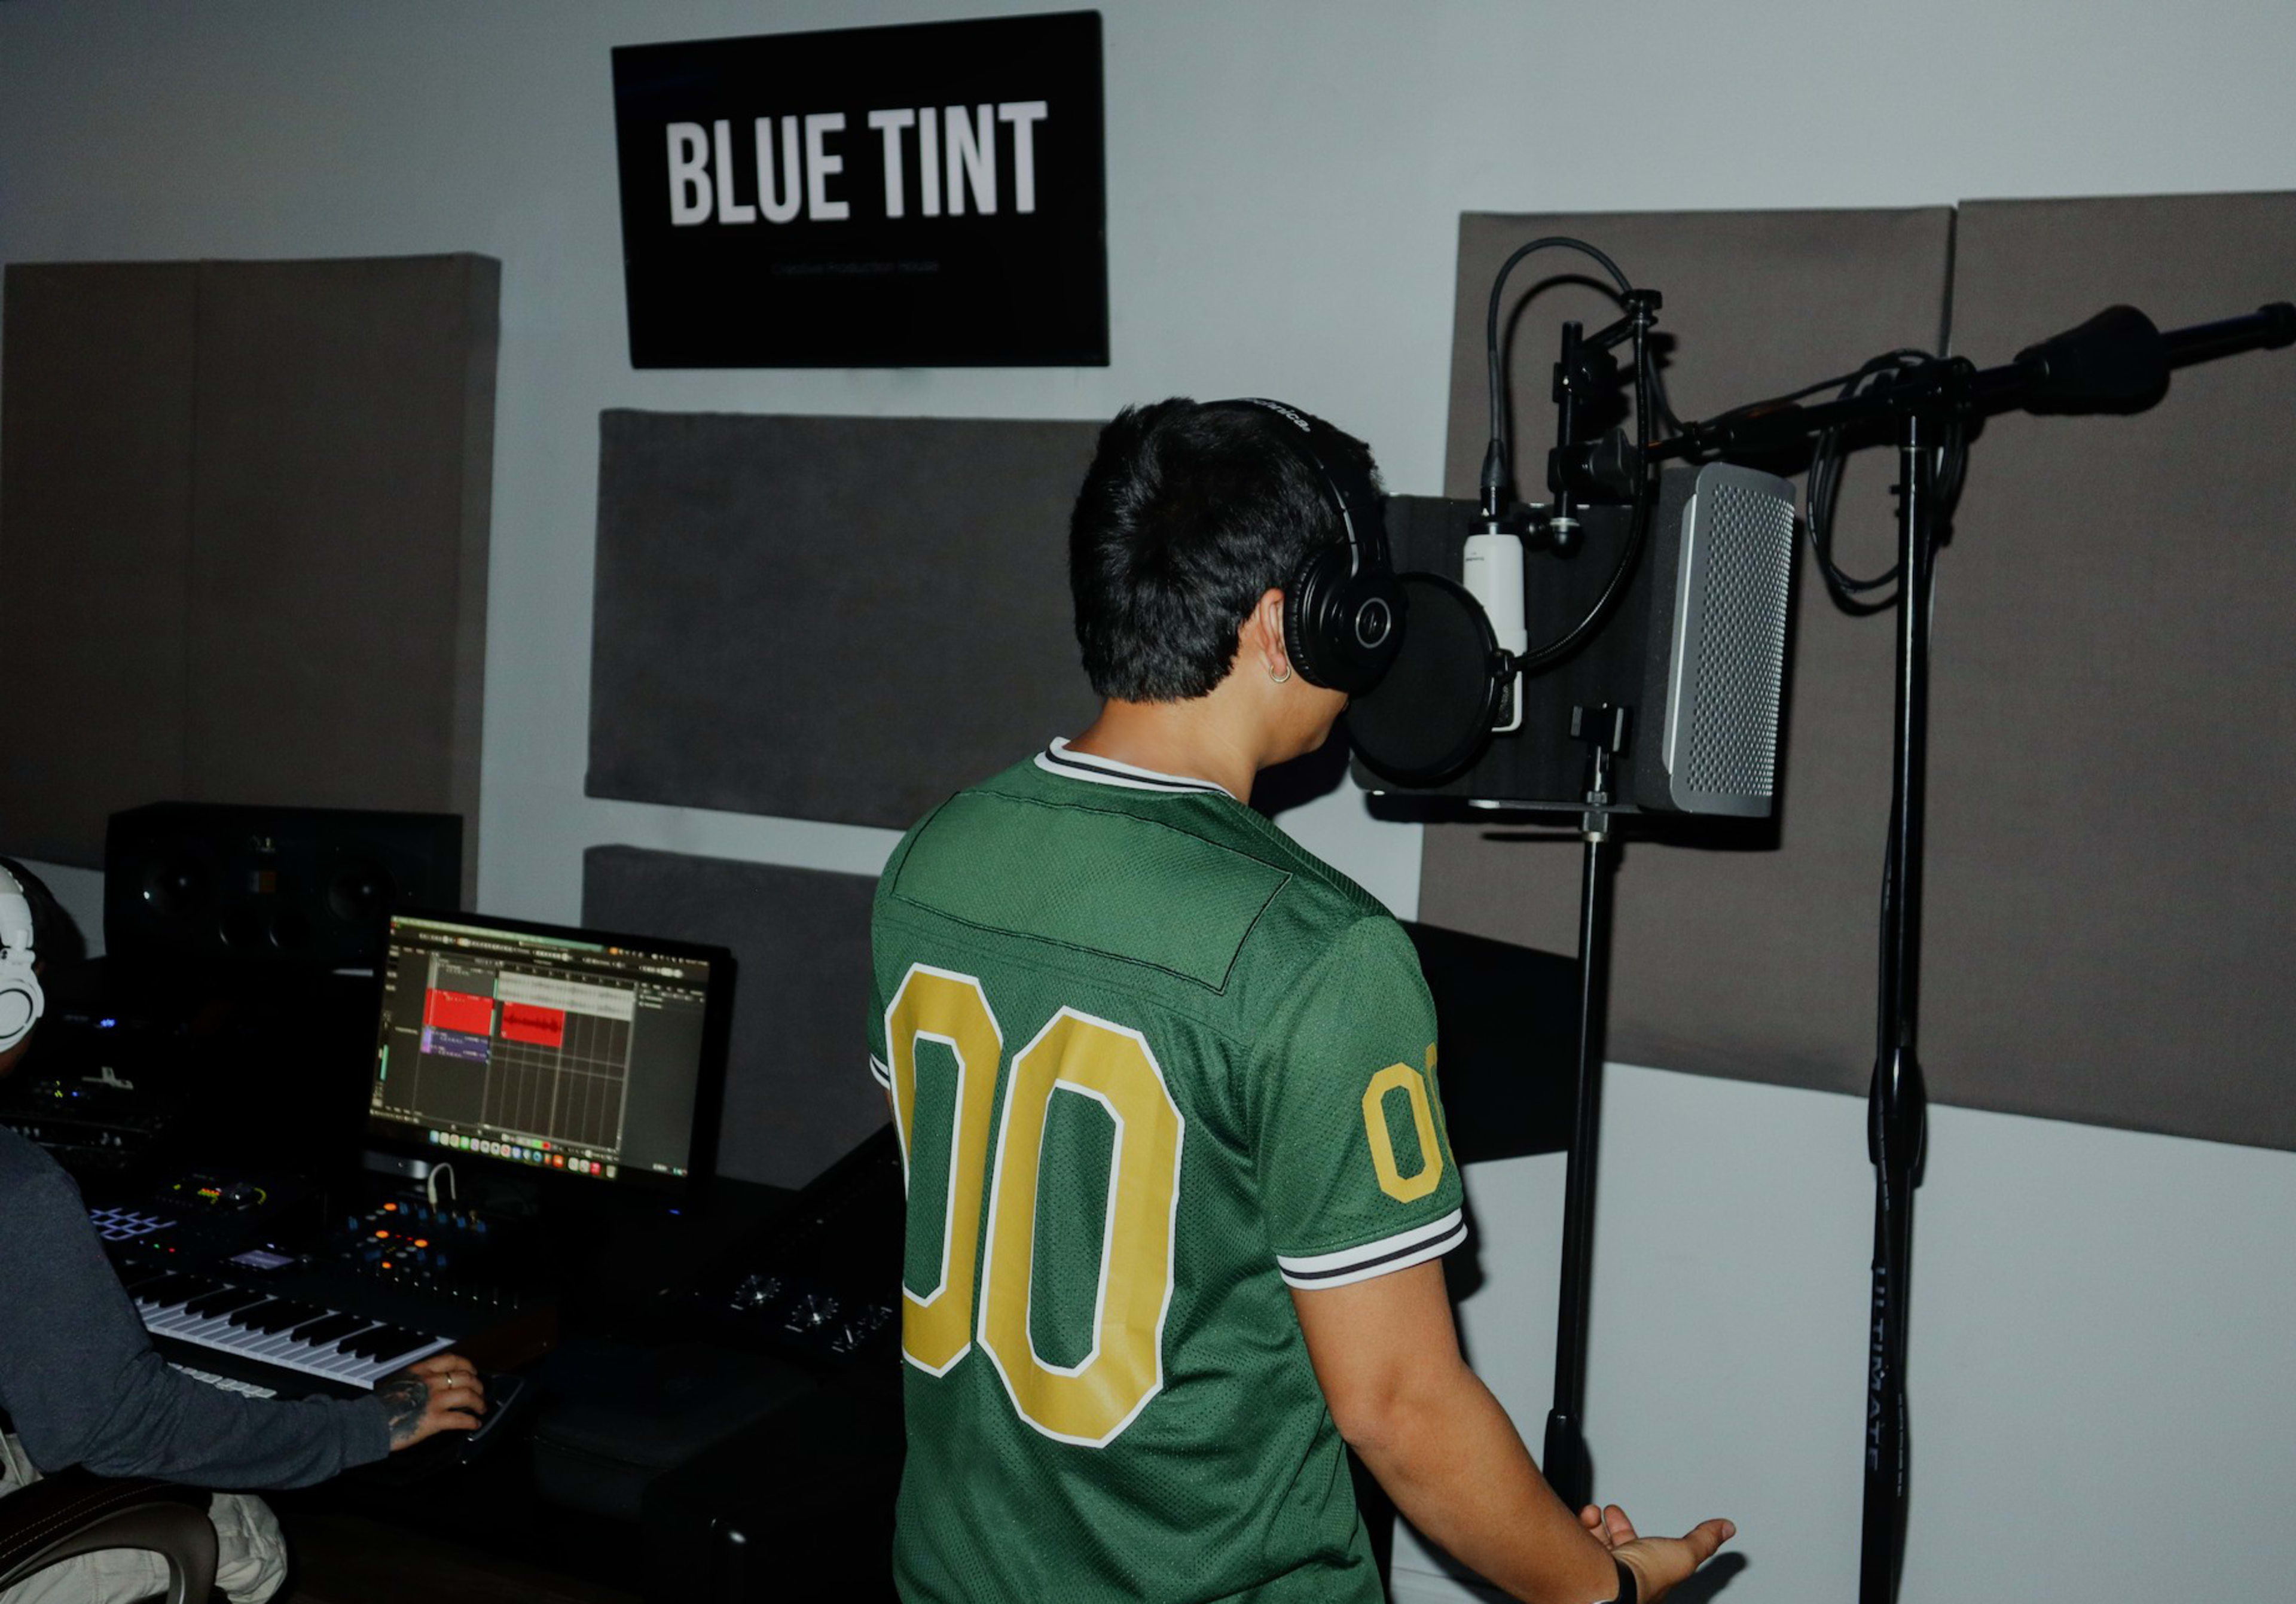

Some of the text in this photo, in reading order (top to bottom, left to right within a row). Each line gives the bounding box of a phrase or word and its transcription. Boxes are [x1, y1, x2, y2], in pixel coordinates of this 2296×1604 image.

[666, 100, 1049, 227] BLUE TINT
[884, 962, 1185, 1449] 00
[1870, 1266, 1886, 1472] ULTIMATE
